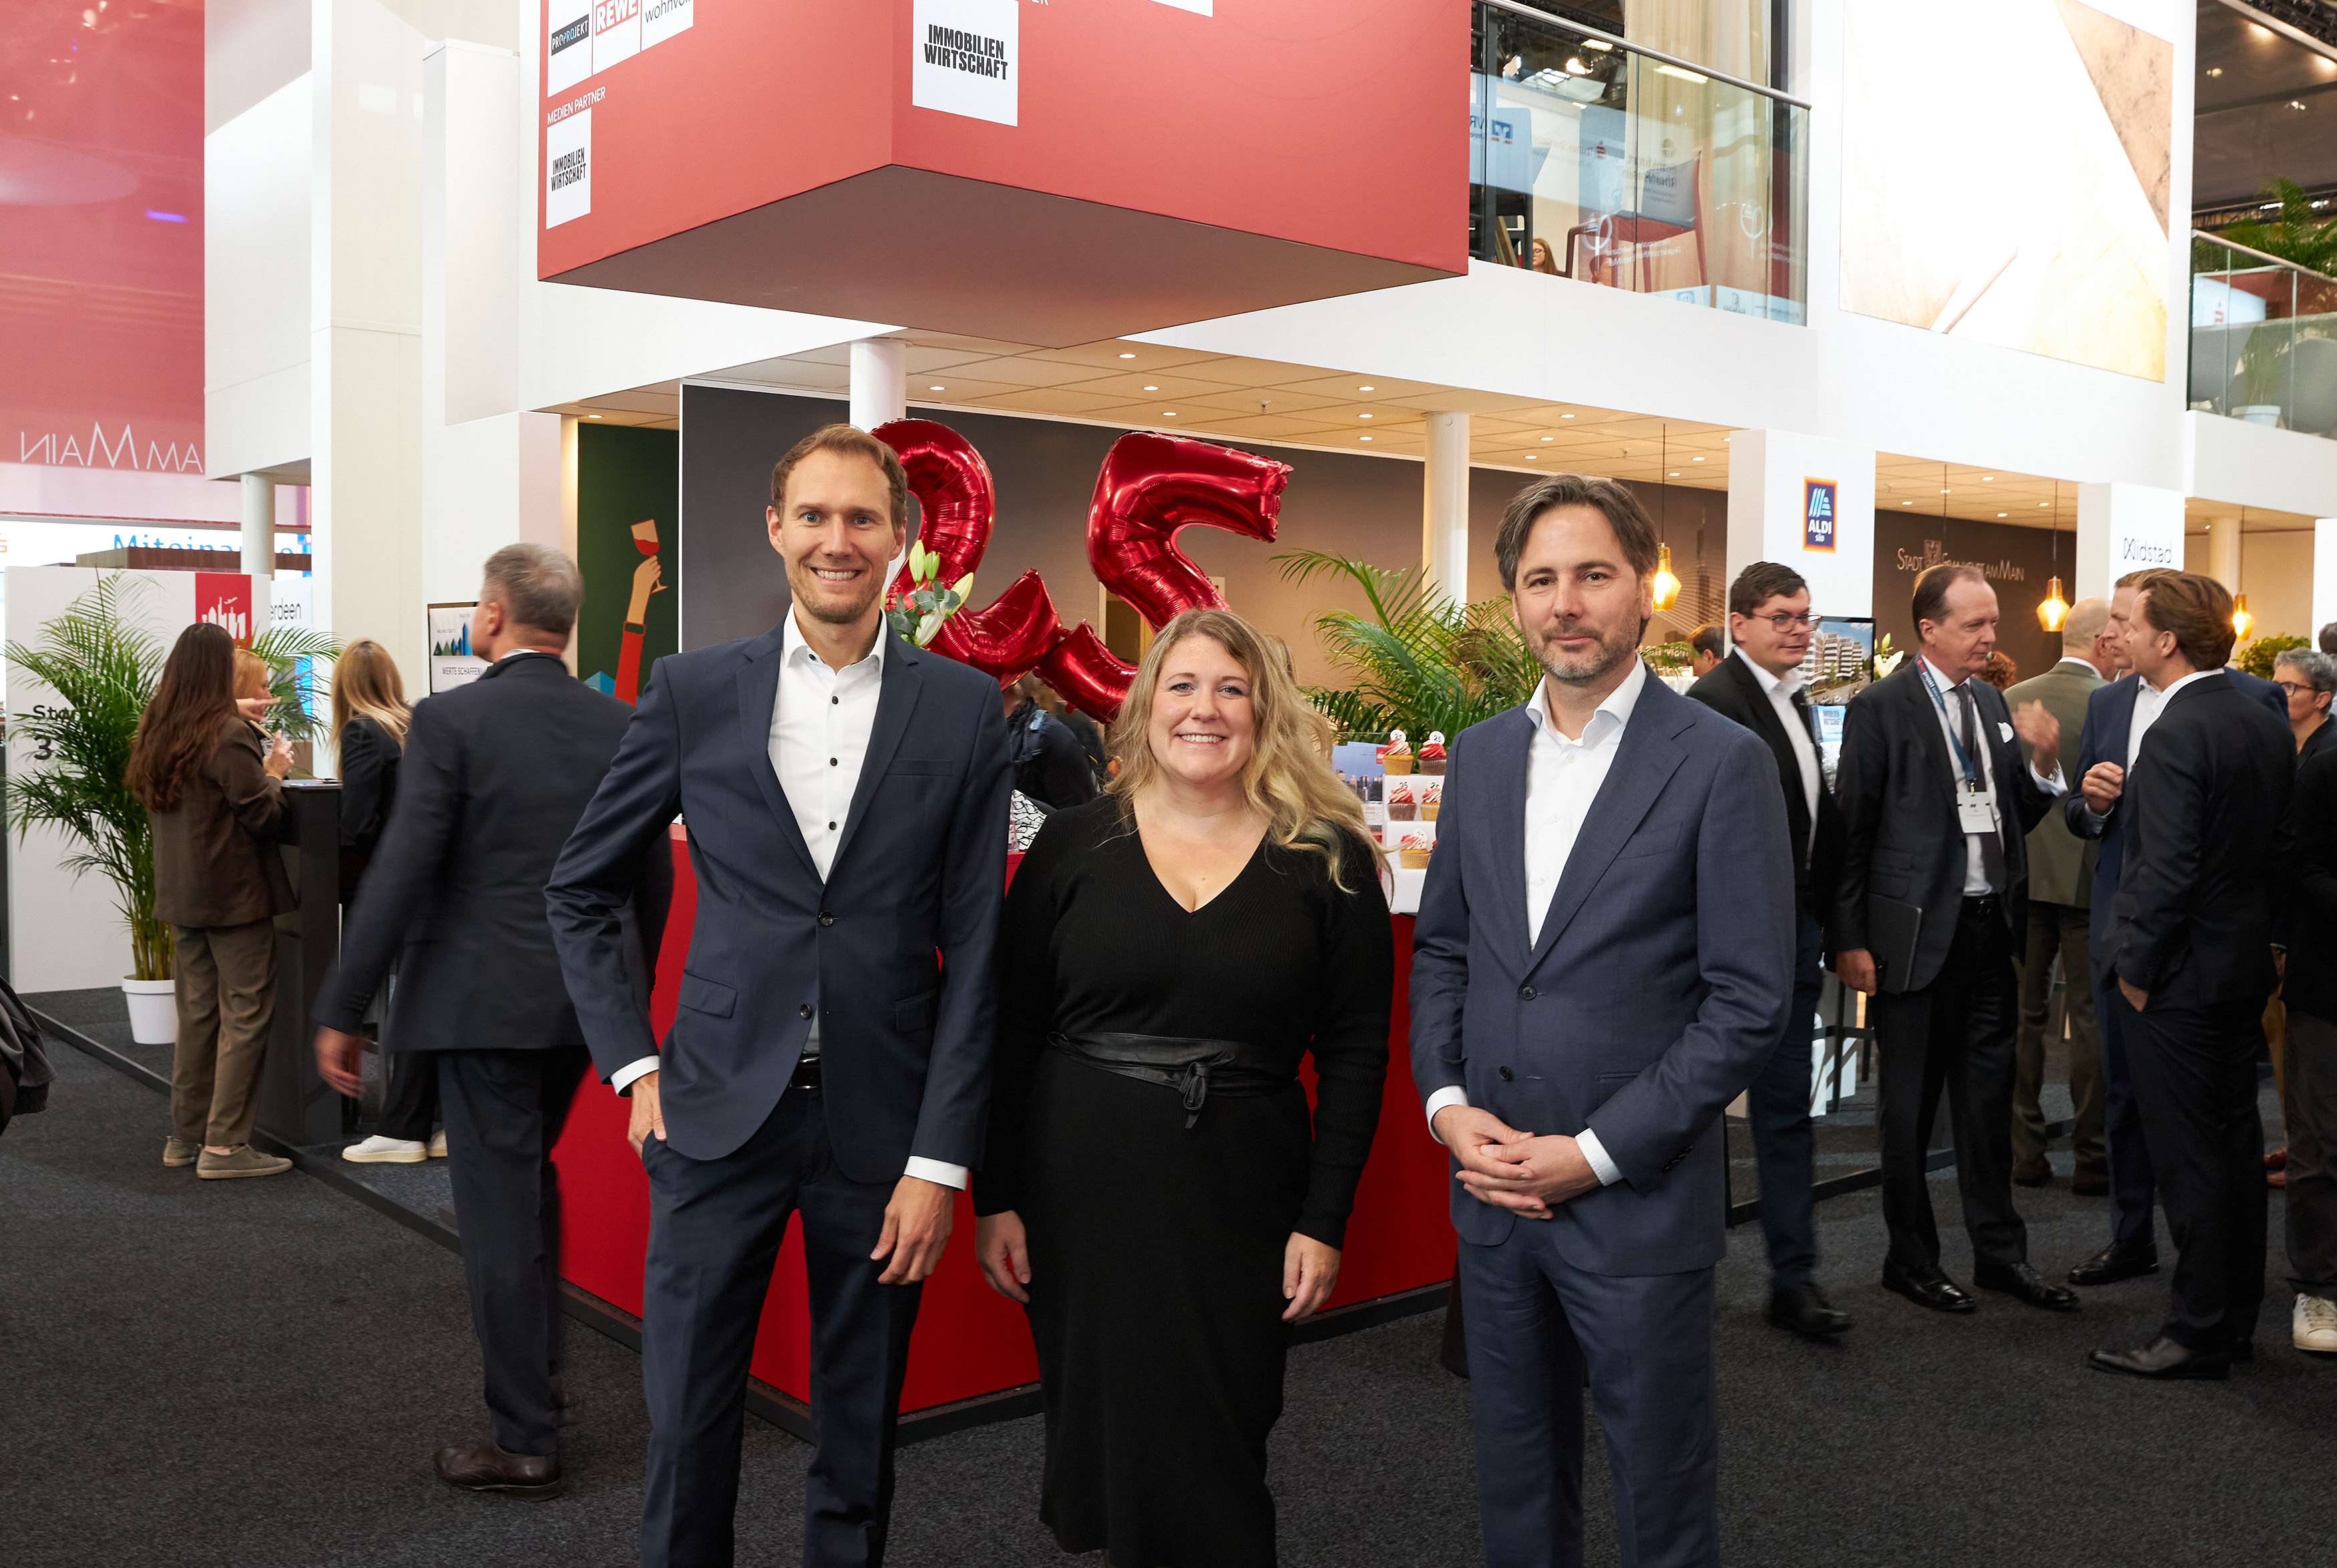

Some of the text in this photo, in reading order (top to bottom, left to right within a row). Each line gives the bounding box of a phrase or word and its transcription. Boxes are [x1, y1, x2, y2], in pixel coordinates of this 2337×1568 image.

[596, 0, 638, 33] REWE
[552, 20, 588, 50] PROPROJEKT
[929, 24, 1004, 59] IMMOBILIEN
[924, 43, 1008, 80] WIRTSCHAFT
[548, 86, 606, 125] MEDIEN PARTNER
[553, 147, 585, 175] IMMOBILIEN
[551, 163, 586, 192] WIRTSCHAFT
[1808, 519, 1832, 535] ALDI
